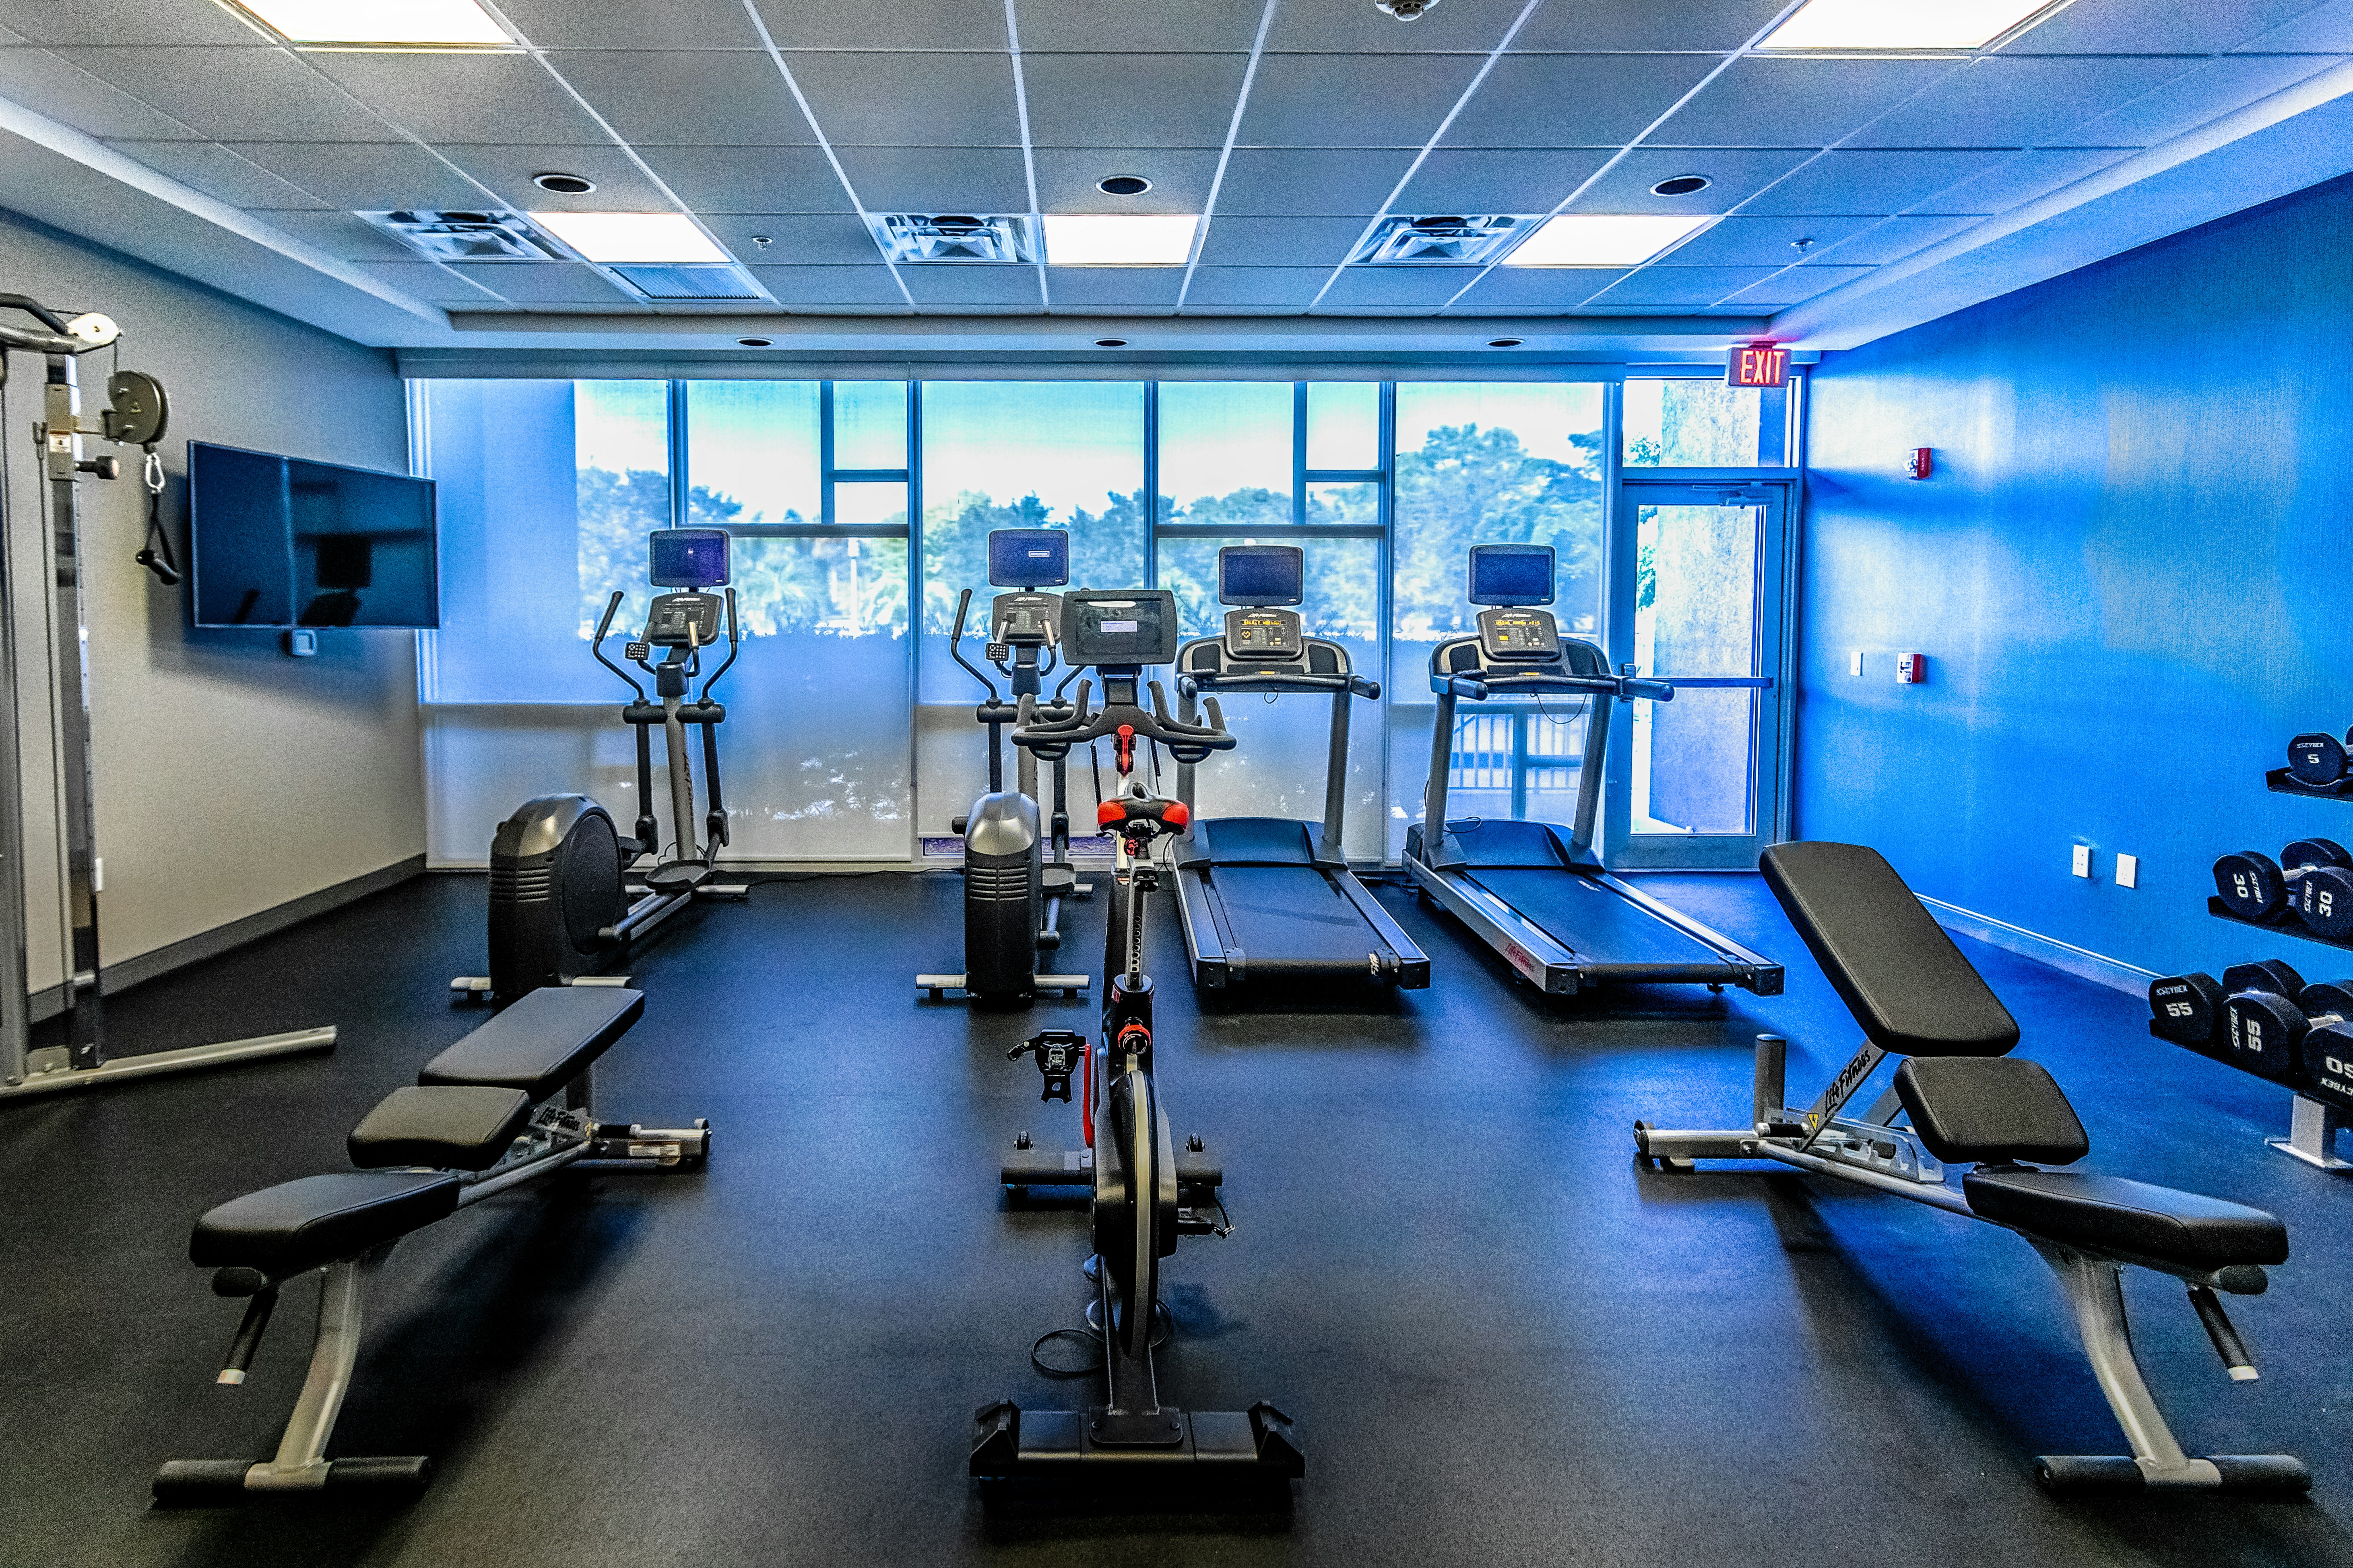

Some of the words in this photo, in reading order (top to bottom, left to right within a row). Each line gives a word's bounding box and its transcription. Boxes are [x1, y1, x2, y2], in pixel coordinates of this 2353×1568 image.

[1740, 350, 1785, 385] EXIT
[2307, 754, 2320, 763] 5
[2233, 873, 2248, 897] 30
[2319, 891, 2332, 917] 30
[2165, 985, 2188, 994] CYBEX
[2165, 1002, 2193, 1017] 55
[2230, 1006, 2239, 1036] CYBEX
[2246, 1018, 2262, 1052] 55
